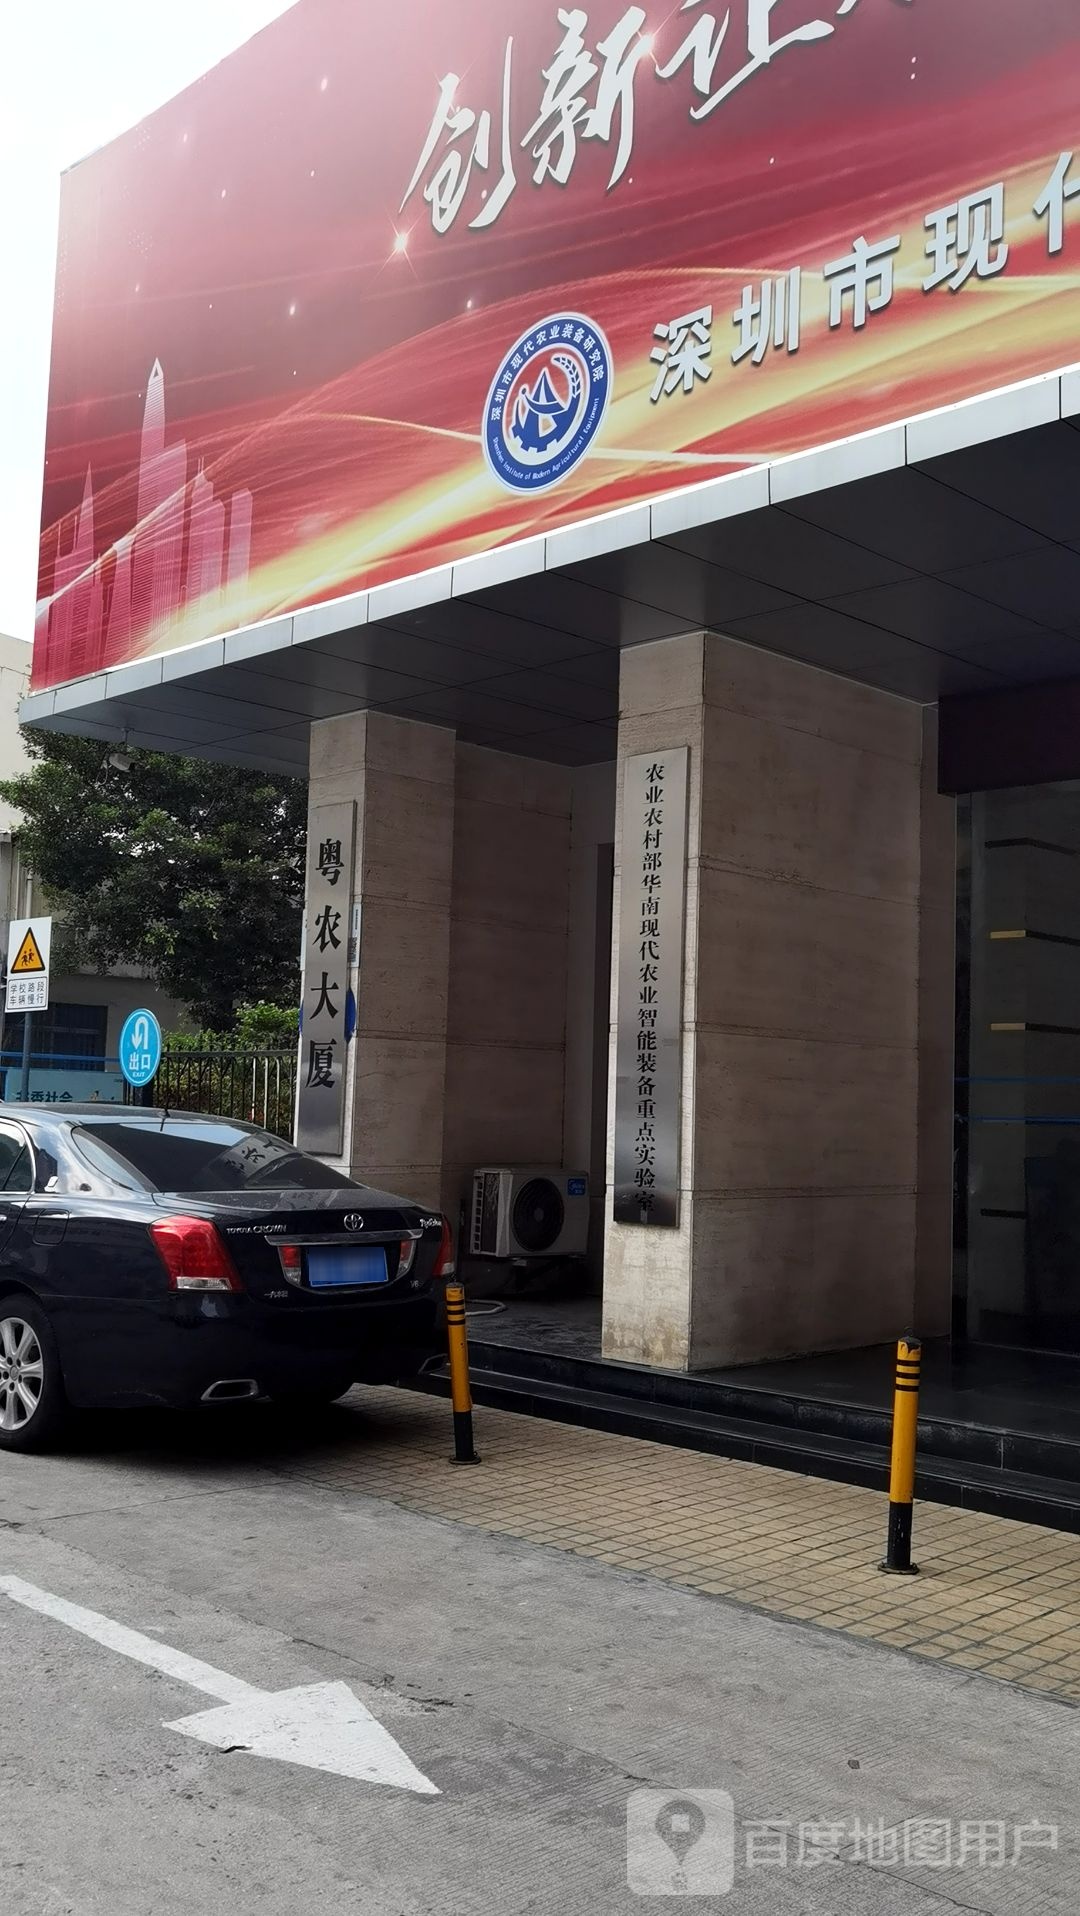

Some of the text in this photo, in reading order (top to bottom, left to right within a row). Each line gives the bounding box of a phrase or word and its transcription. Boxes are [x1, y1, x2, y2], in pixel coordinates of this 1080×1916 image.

[491, 323, 604, 421] 深圳市现代农业装备研究院
[552, 436, 585, 472] Agricultural
[583, 397, 600, 434] Equipment
[305, 838, 345, 1089] 粤农大厦
[634, 763, 665, 1212] 农业农村部华南现代农业智能装备重点实验室
[129, 1051, 151, 1071] 出口
[252, 1224, 287, 1234] CROWN
